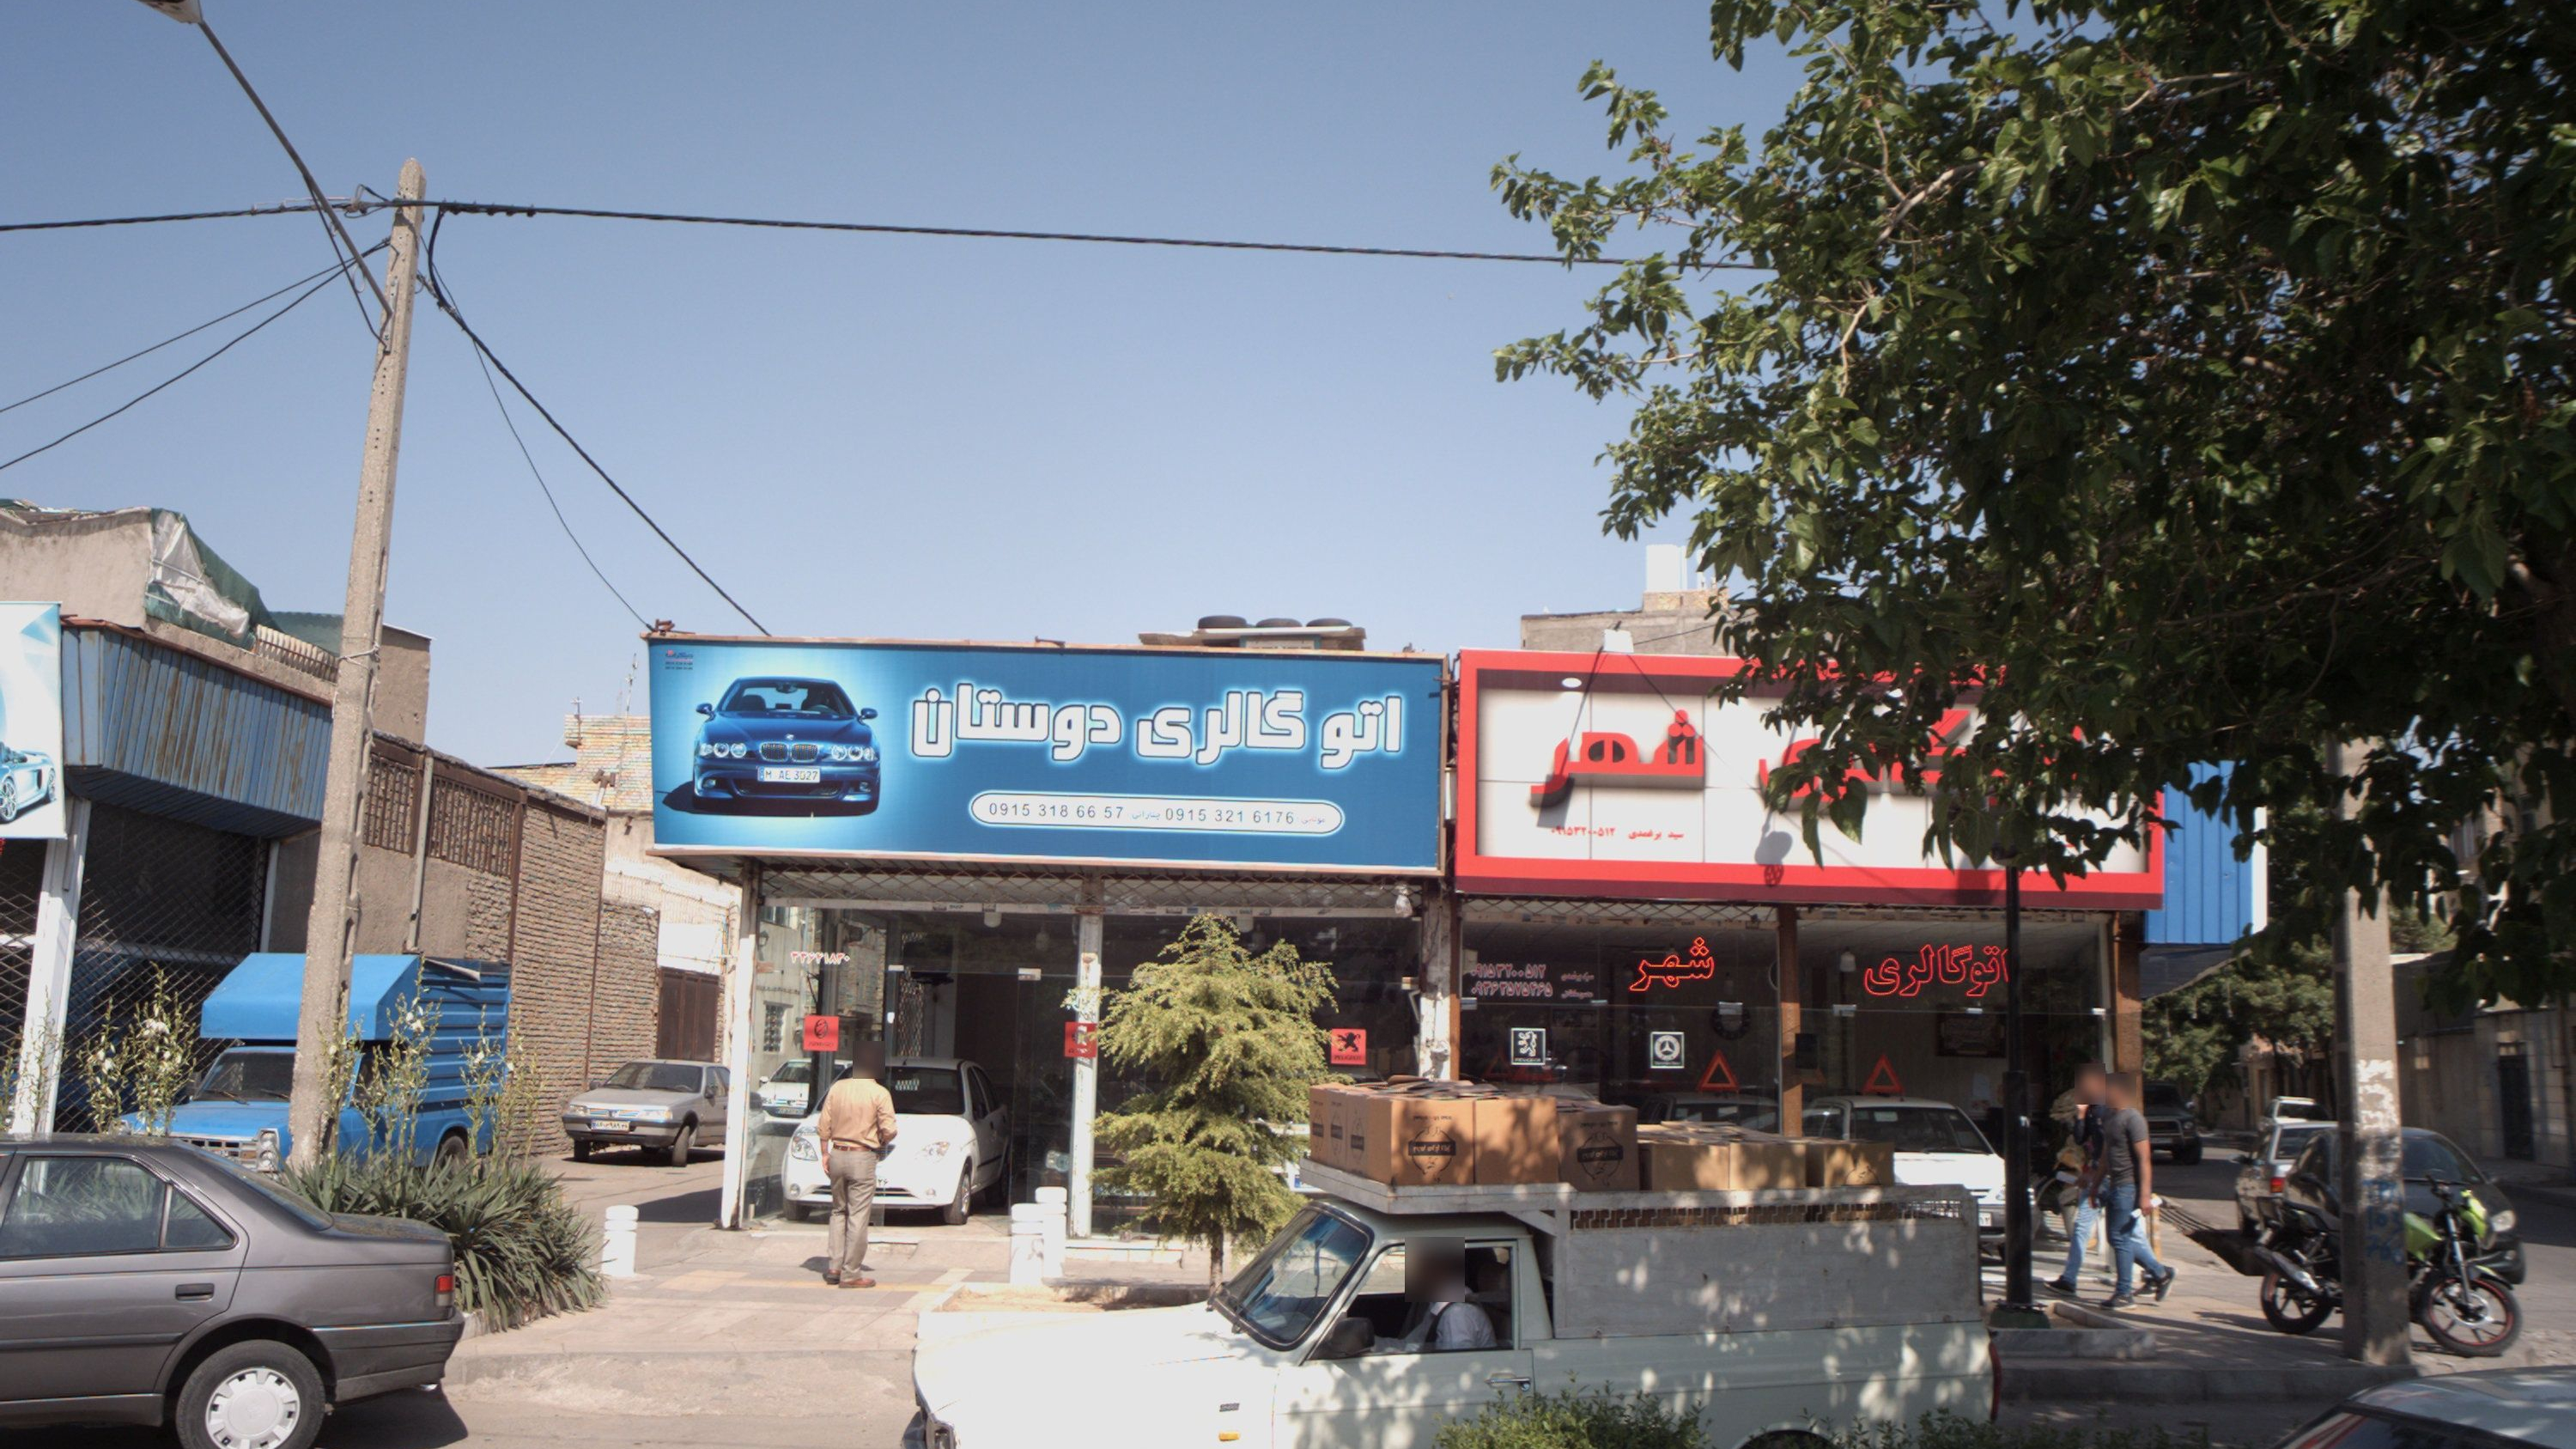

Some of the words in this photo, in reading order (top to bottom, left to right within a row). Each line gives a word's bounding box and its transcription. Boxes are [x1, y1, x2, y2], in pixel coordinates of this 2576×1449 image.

[912, 683, 1121, 761] دوستان
[1136, 691, 1306, 764] گالری
[1321, 696, 1402, 769] اتو
[1530, 709, 1704, 796] شهر
[989, 802, 1030, 817] 0915
[1038, 804, 1068, 818] 318
[1076, 805, 1097, 819] 66
[1104, 806, 1124, 819] 57
[1165, 807, 1206, 821] 0915
[1215, 809, 1243, 822] 321
[1253, 810, 1294, 824] 6176
[1629, 934, 1716, 992] شهر
